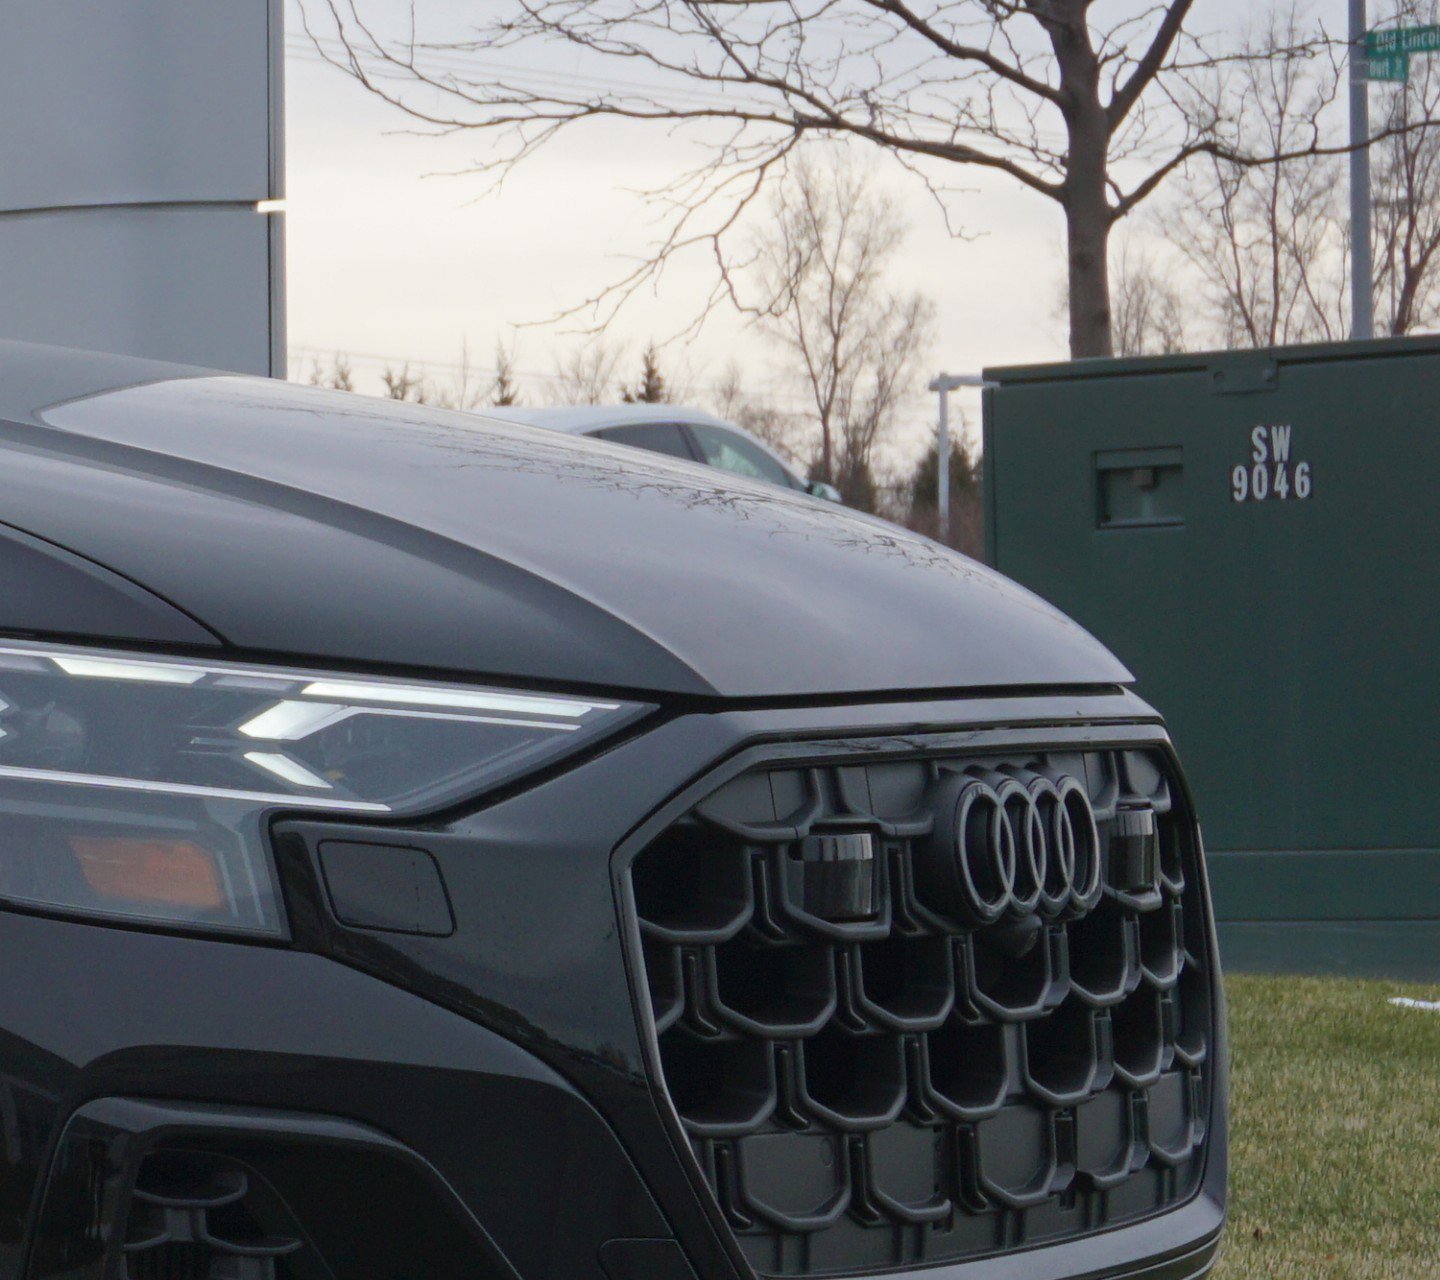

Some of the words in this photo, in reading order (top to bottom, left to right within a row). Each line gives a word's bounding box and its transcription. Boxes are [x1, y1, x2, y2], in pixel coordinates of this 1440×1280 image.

[1376, 31, 1397, 53] Old
[1251, 425, 1291, 462] SW
[1232, 462, 1311, 502] 9046
